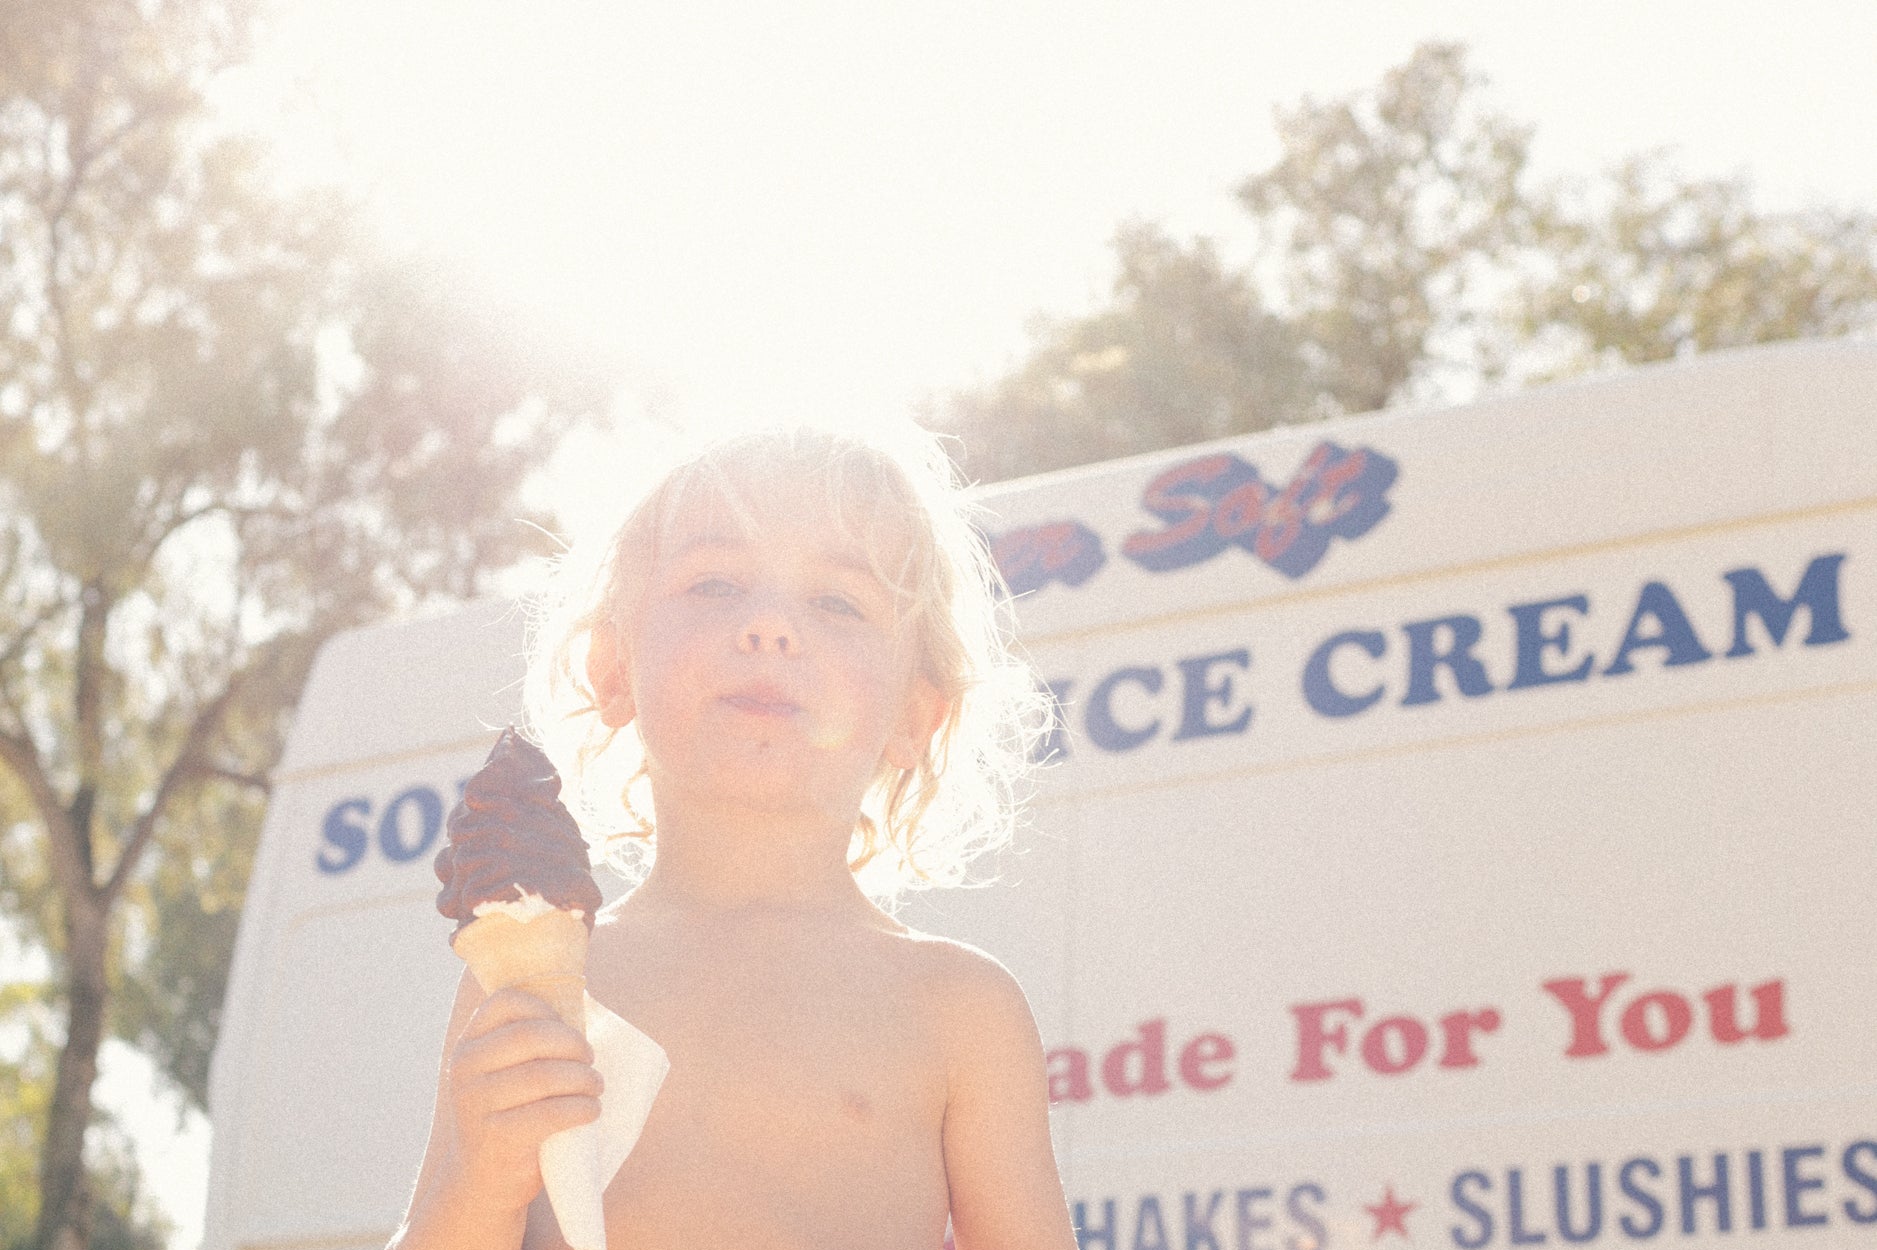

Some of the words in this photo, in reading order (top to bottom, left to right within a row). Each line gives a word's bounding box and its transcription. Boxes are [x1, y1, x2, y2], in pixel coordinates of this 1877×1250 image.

[1123, 441, 1399, 580] Soft
[315, 778, 474, 876] SO
[1032, 649, 1253, 765] ICE
[1300, 552, 1852, 720] CREAM
[1046, 1016, 1235, 1103] ade
[1290, 997, 1501, 1082] For
[1540, 970, 1792, 1059] You
[1450, 1138, 1877, 1250] SLUSHIES
